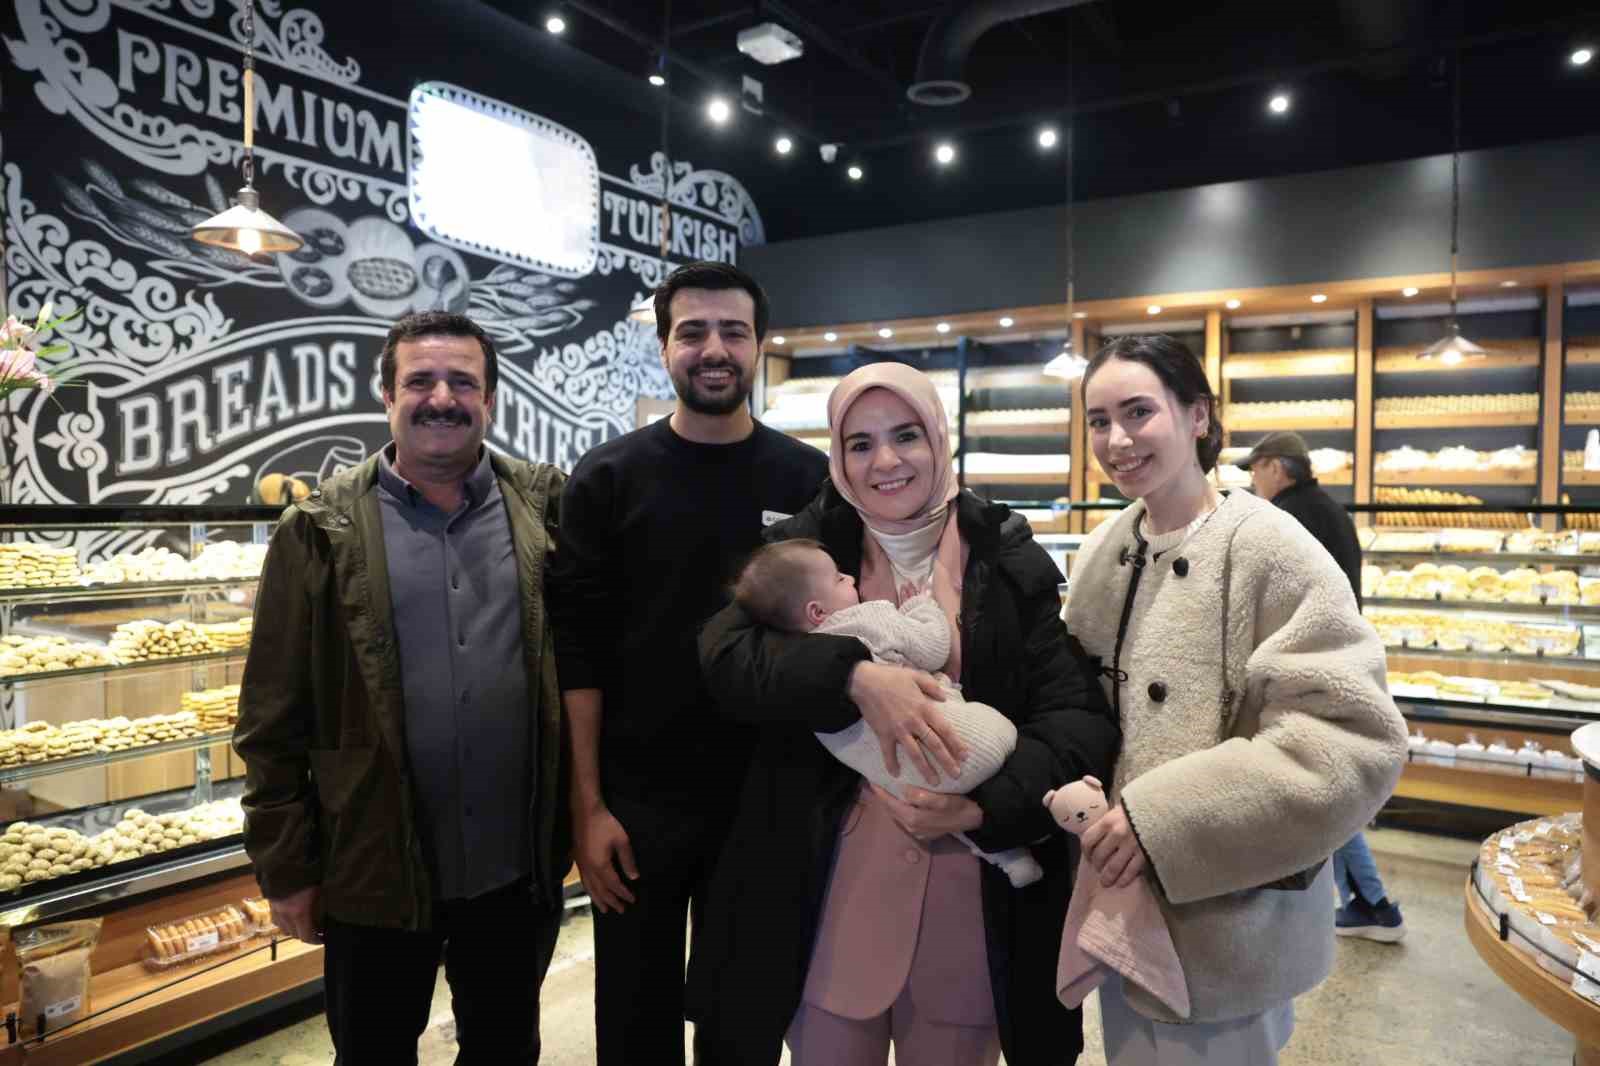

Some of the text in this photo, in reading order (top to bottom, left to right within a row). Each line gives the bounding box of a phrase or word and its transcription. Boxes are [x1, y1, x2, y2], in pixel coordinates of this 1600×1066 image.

[117, 28, 736, 269] PREMIUM TURKISH
[117, 341, 356, 474] BREADS
